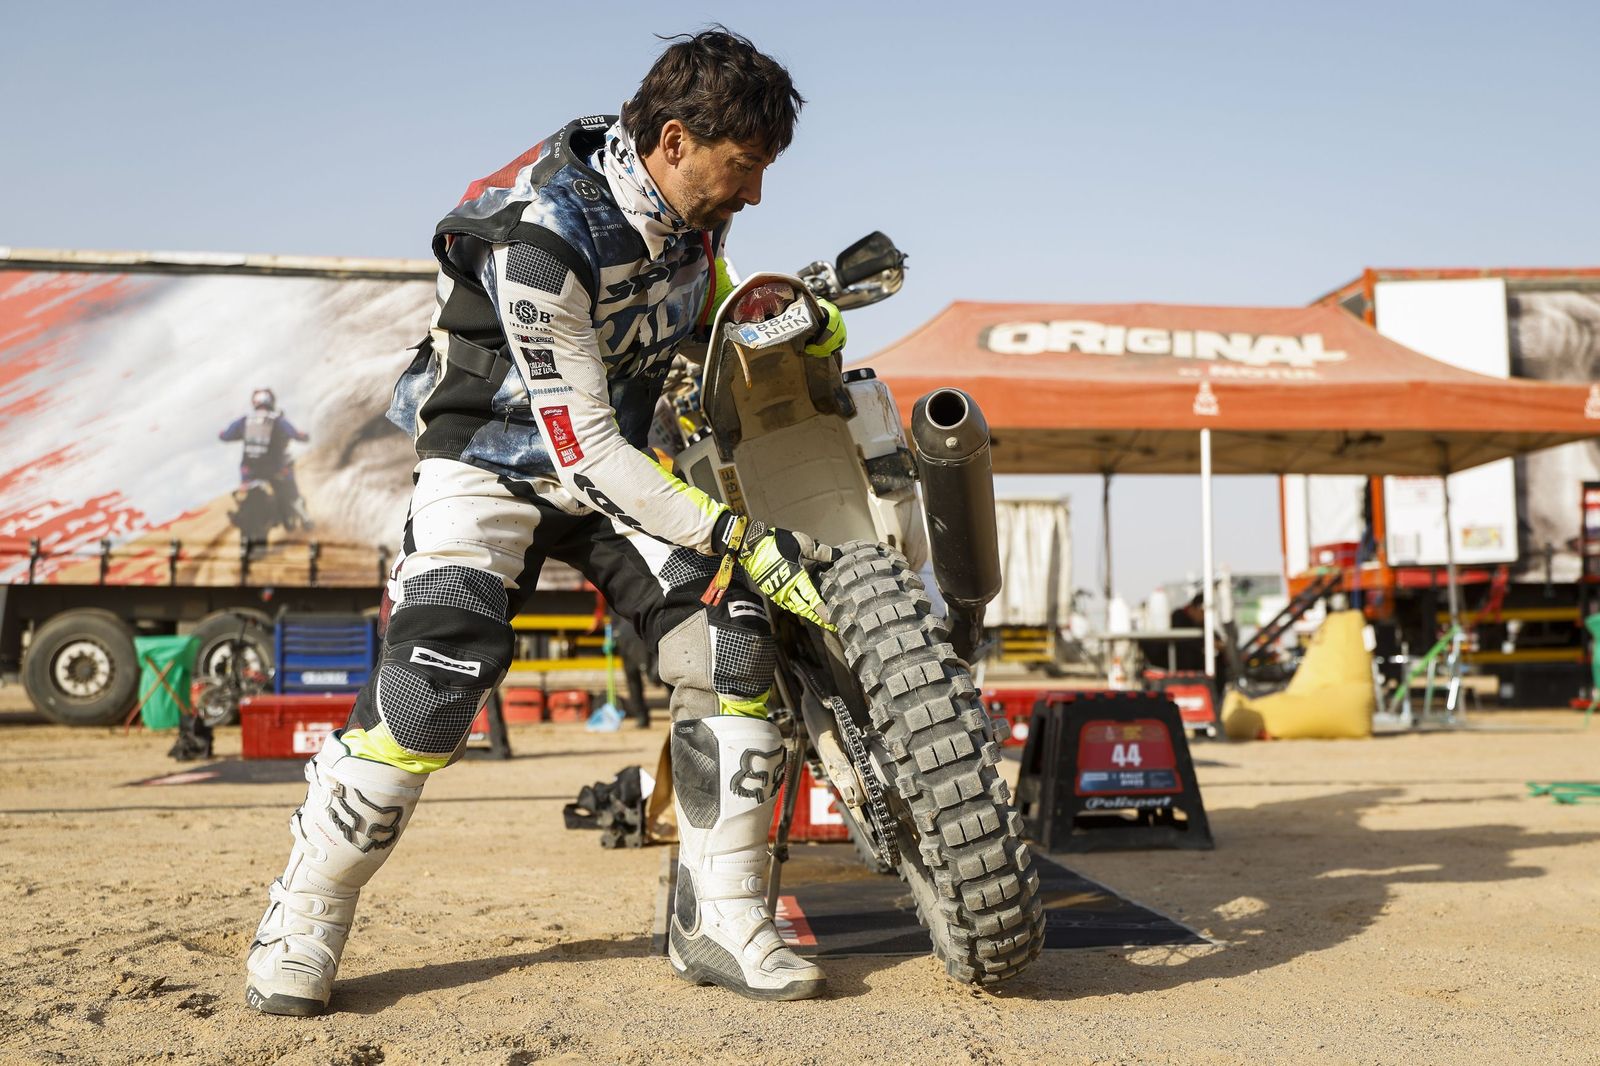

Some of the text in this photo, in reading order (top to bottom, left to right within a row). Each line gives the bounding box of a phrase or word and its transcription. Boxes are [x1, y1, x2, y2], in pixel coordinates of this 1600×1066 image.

[580, 115, 605, 125] RALLY
[755, 304, 804, 332] 8847
[765, 315, 809, 339] NHN
[986, 320, 1347, 367] ORIGINAL
[1111, 743, 1143, 767] 44
[1085, 796, 1172, 810] Polisport
[247, 988, 265, 1011] FOX
